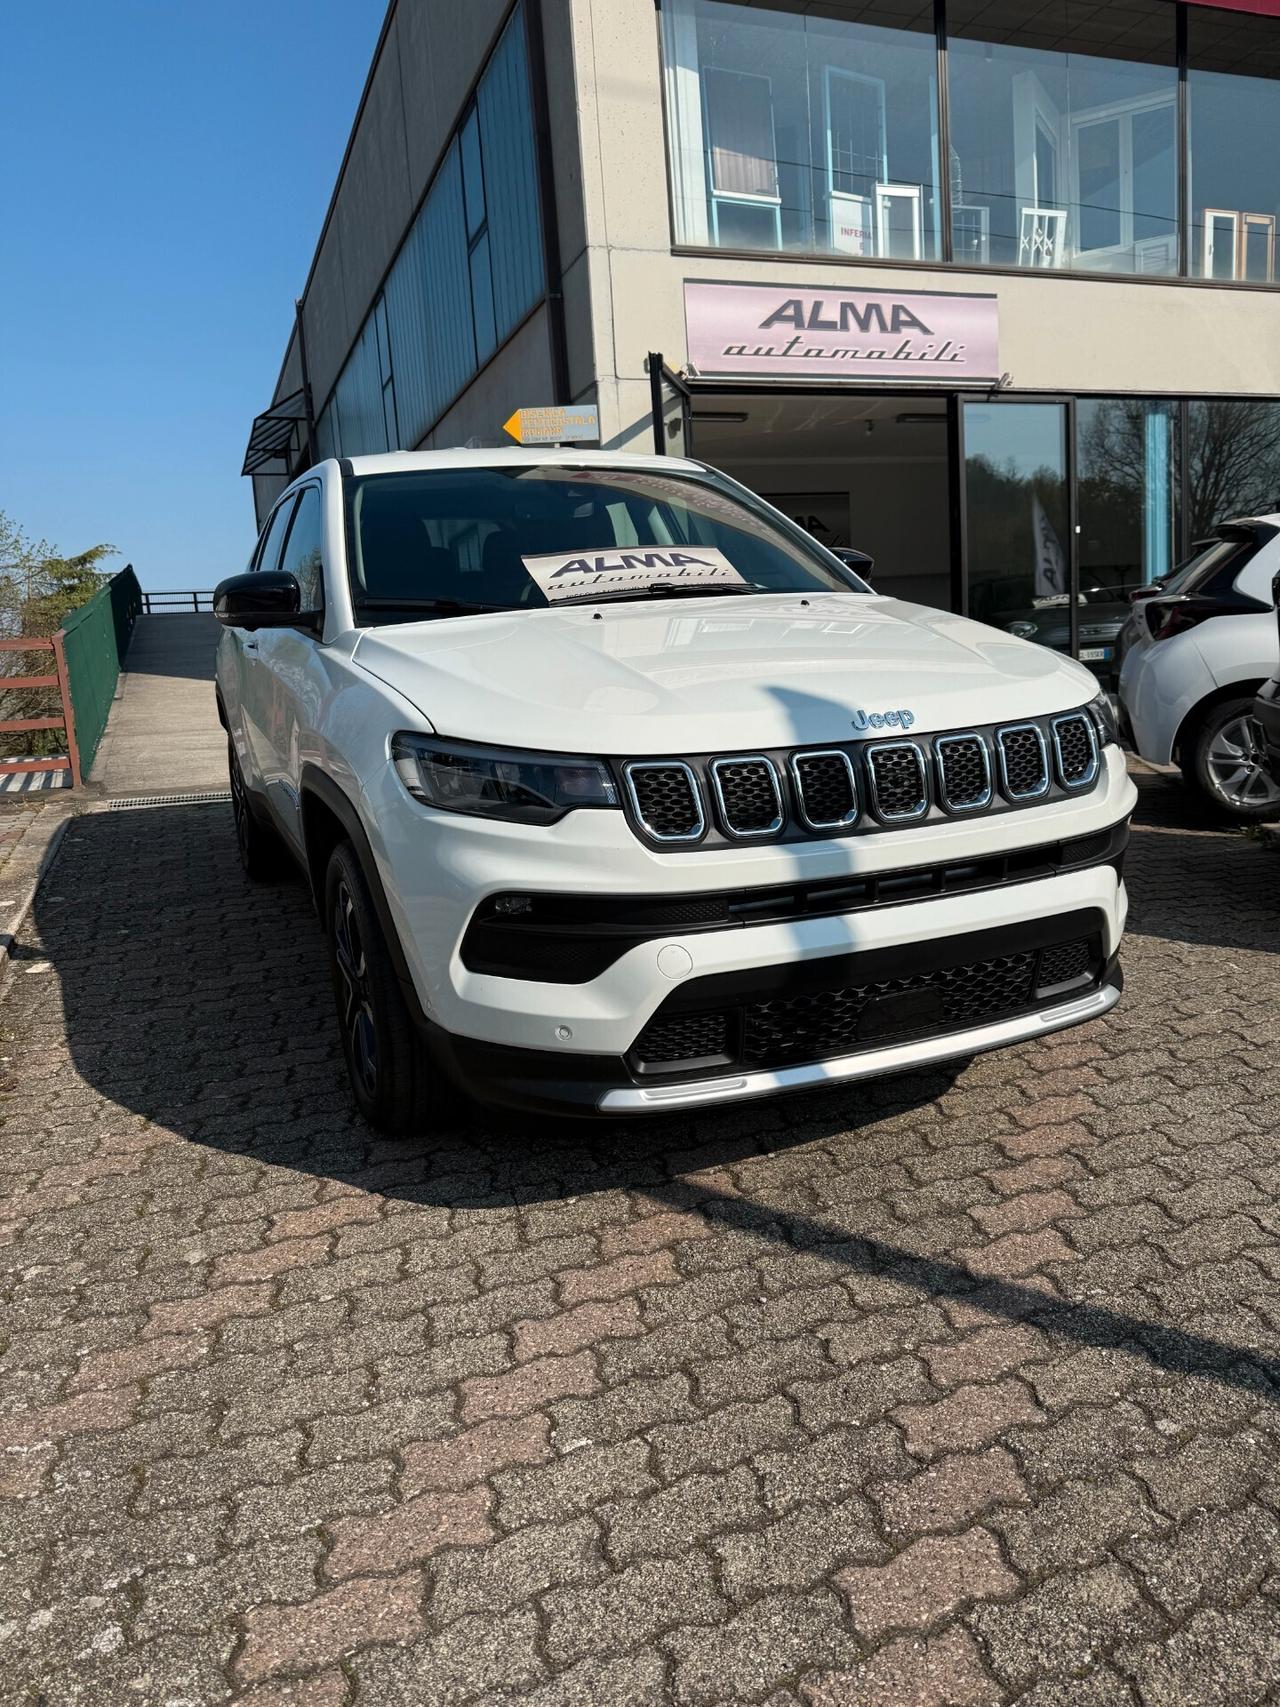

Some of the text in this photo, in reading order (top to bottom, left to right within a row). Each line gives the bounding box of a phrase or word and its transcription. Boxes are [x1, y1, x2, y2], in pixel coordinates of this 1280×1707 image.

[759, 298, 935, 335] ALMA
[723, 335, 966, 363] automobili
[547, 567, 734, 591] automobili
[549, 552, 716, 579] ALMA
[851, 709, 915, 731] Jeep
